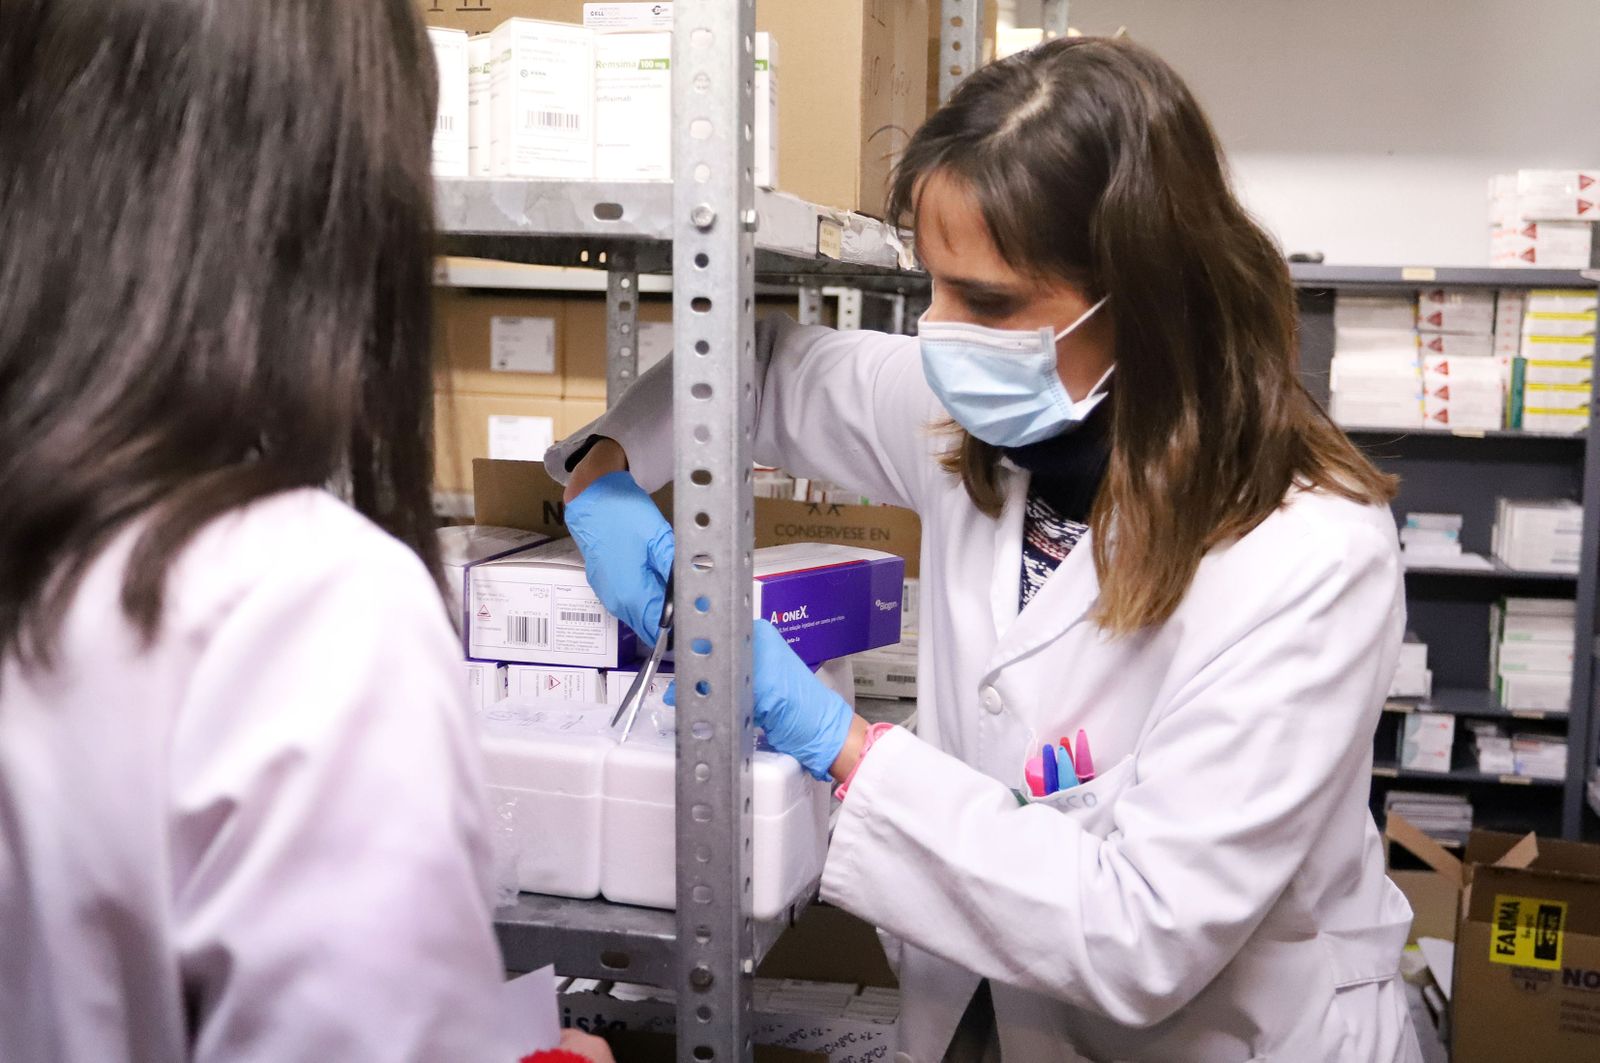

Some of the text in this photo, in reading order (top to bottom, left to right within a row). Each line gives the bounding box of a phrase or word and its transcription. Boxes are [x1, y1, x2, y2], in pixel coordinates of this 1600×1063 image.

[595, 60, 637, 70] Remsima
[641, 60, 654, 69] 100
[869, 527, 891, 542] EN
[1496, 901, 1521, 956] FARMA
